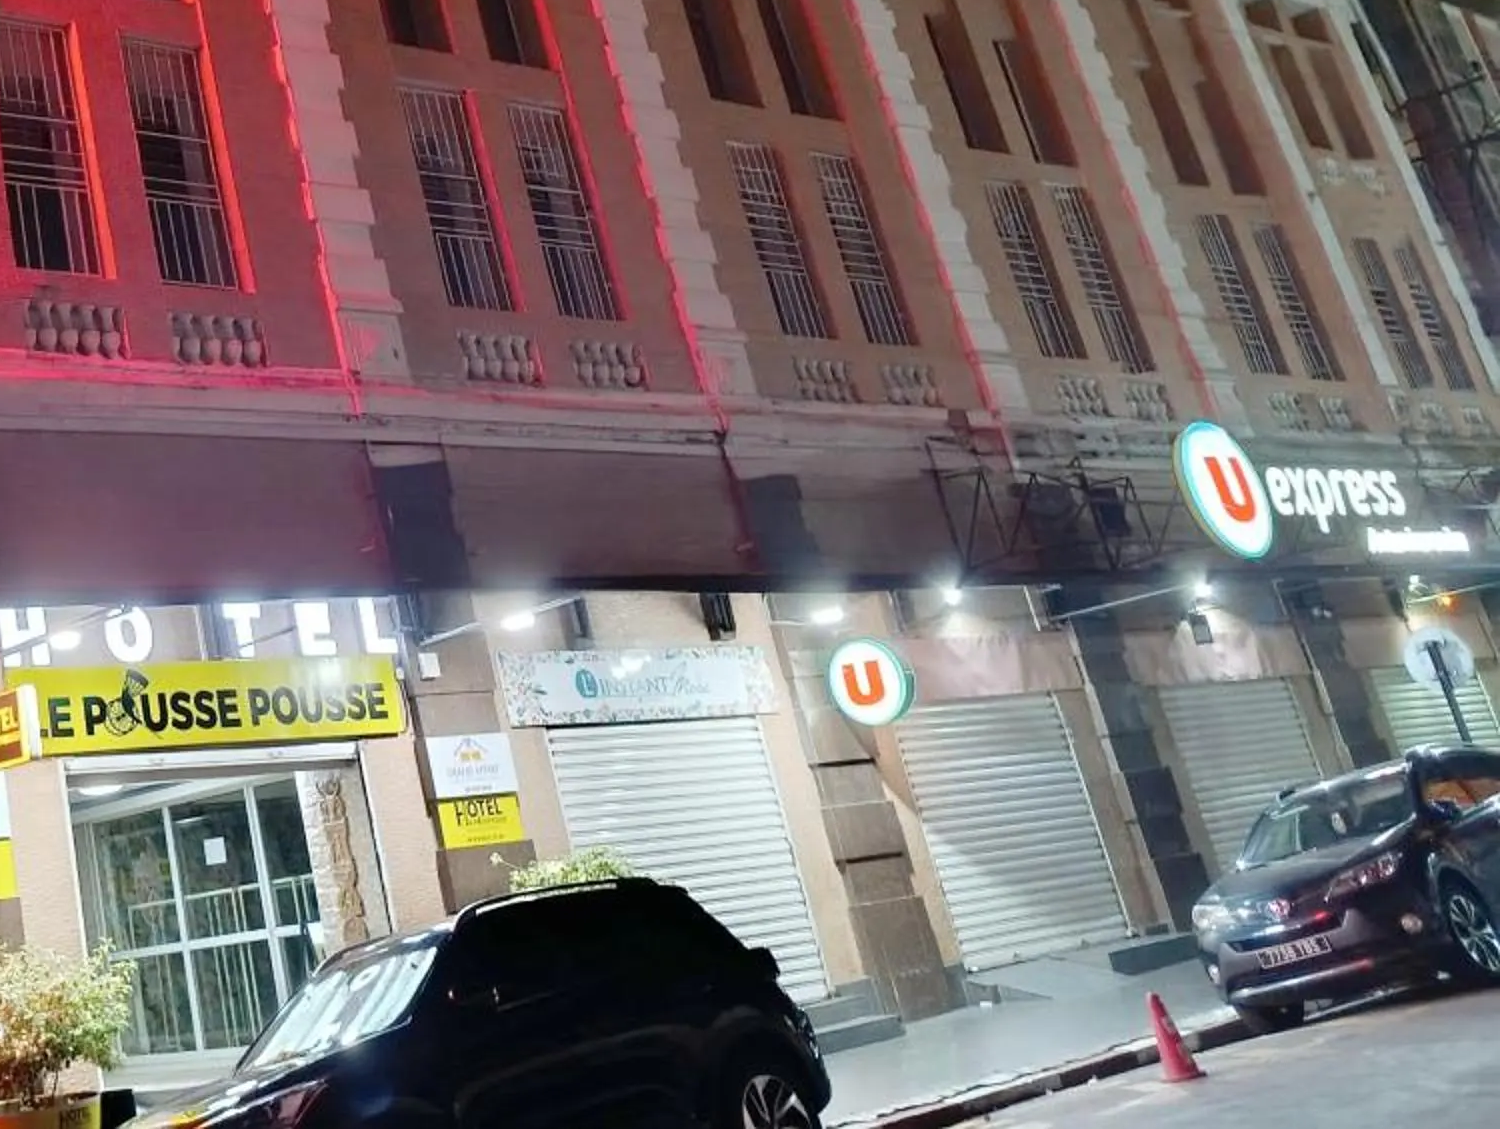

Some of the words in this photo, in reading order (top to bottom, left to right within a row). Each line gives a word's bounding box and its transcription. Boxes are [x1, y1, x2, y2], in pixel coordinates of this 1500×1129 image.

[1203, 456, 1256, 522] U
[1265, 466, 1406, 534] express
[248, 682, 389, 727] POUSSE
[841, 660, 885, 705] U
[453, 796, 503, 828] HOTEL
